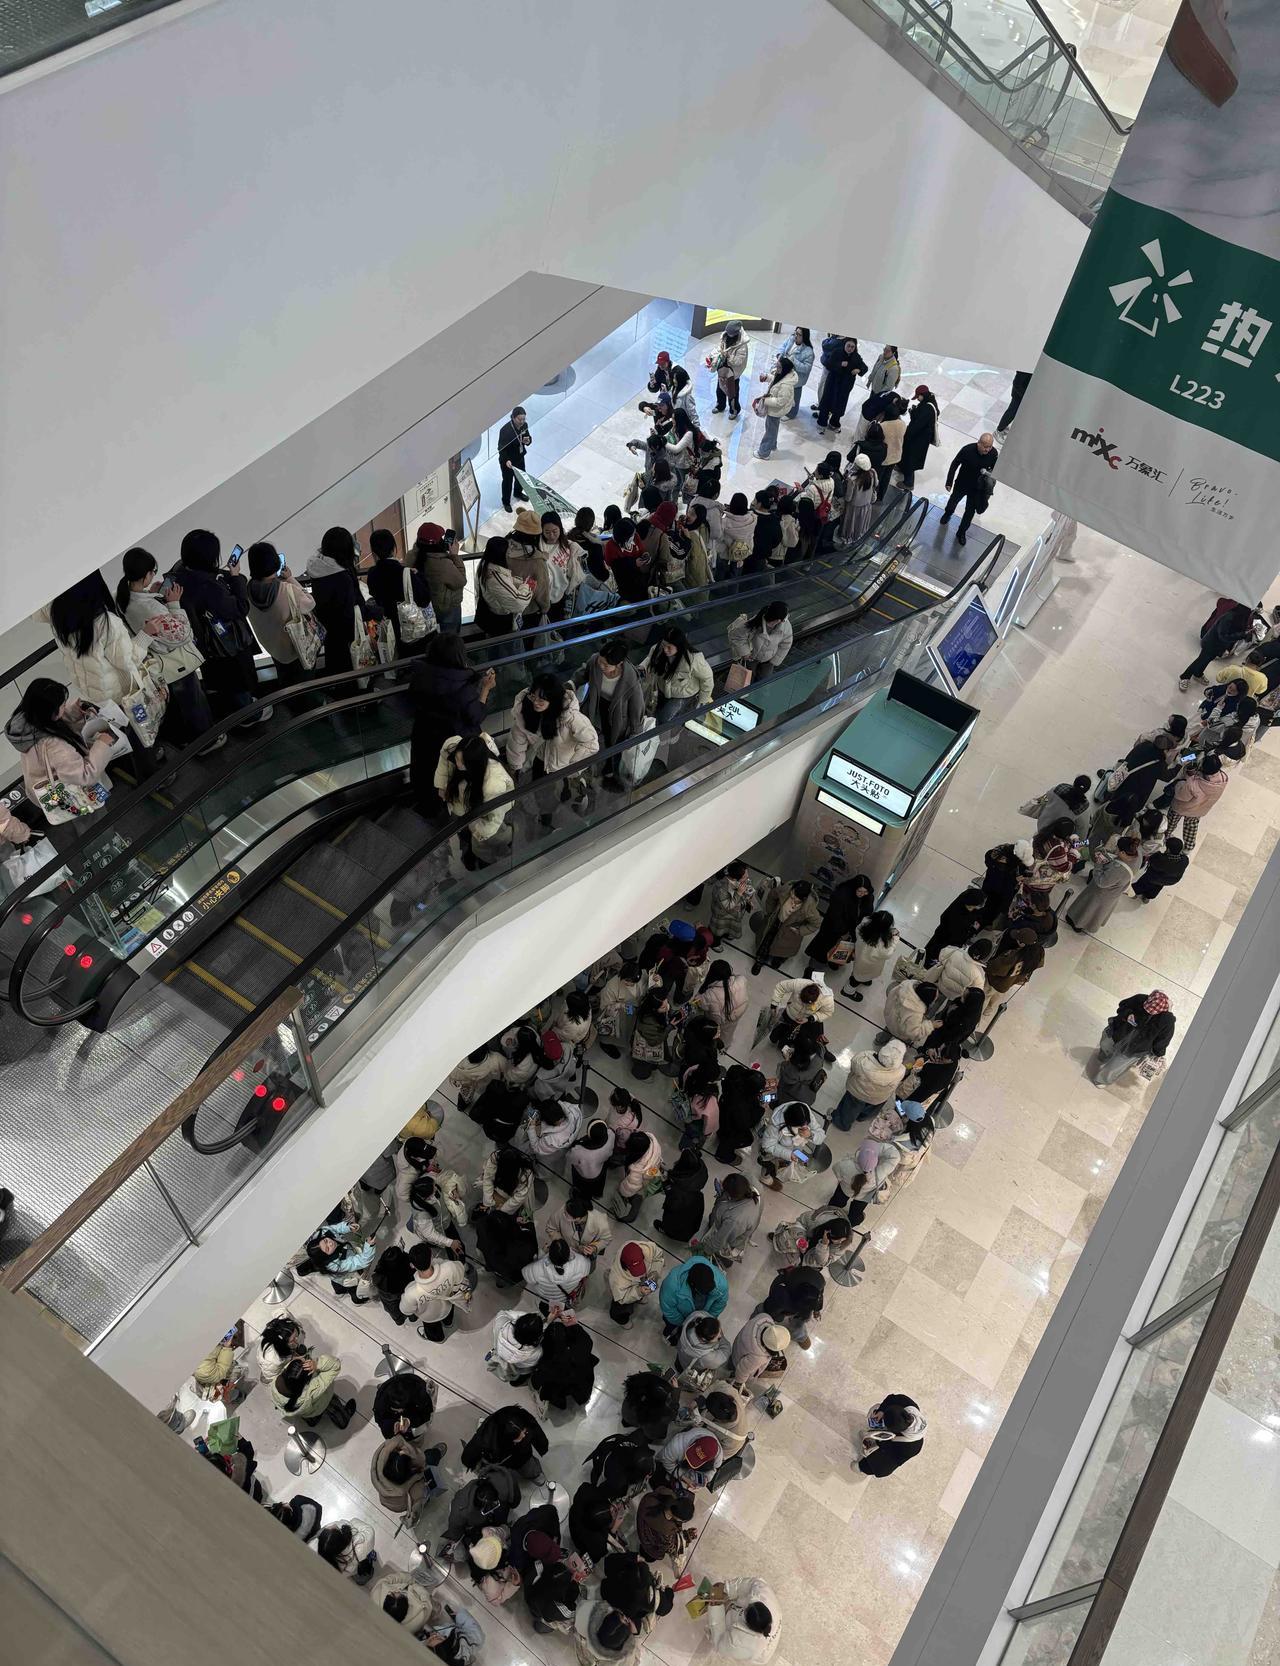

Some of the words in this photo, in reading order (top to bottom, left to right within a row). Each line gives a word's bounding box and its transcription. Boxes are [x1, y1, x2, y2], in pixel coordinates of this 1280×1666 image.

[1201, 301, 1280, 382] 热
[1170, 374, 1226, 409] L223
[846, 769, 890, 796] JUST.FOTO
[851, 779, 880, 799] 大头贴
